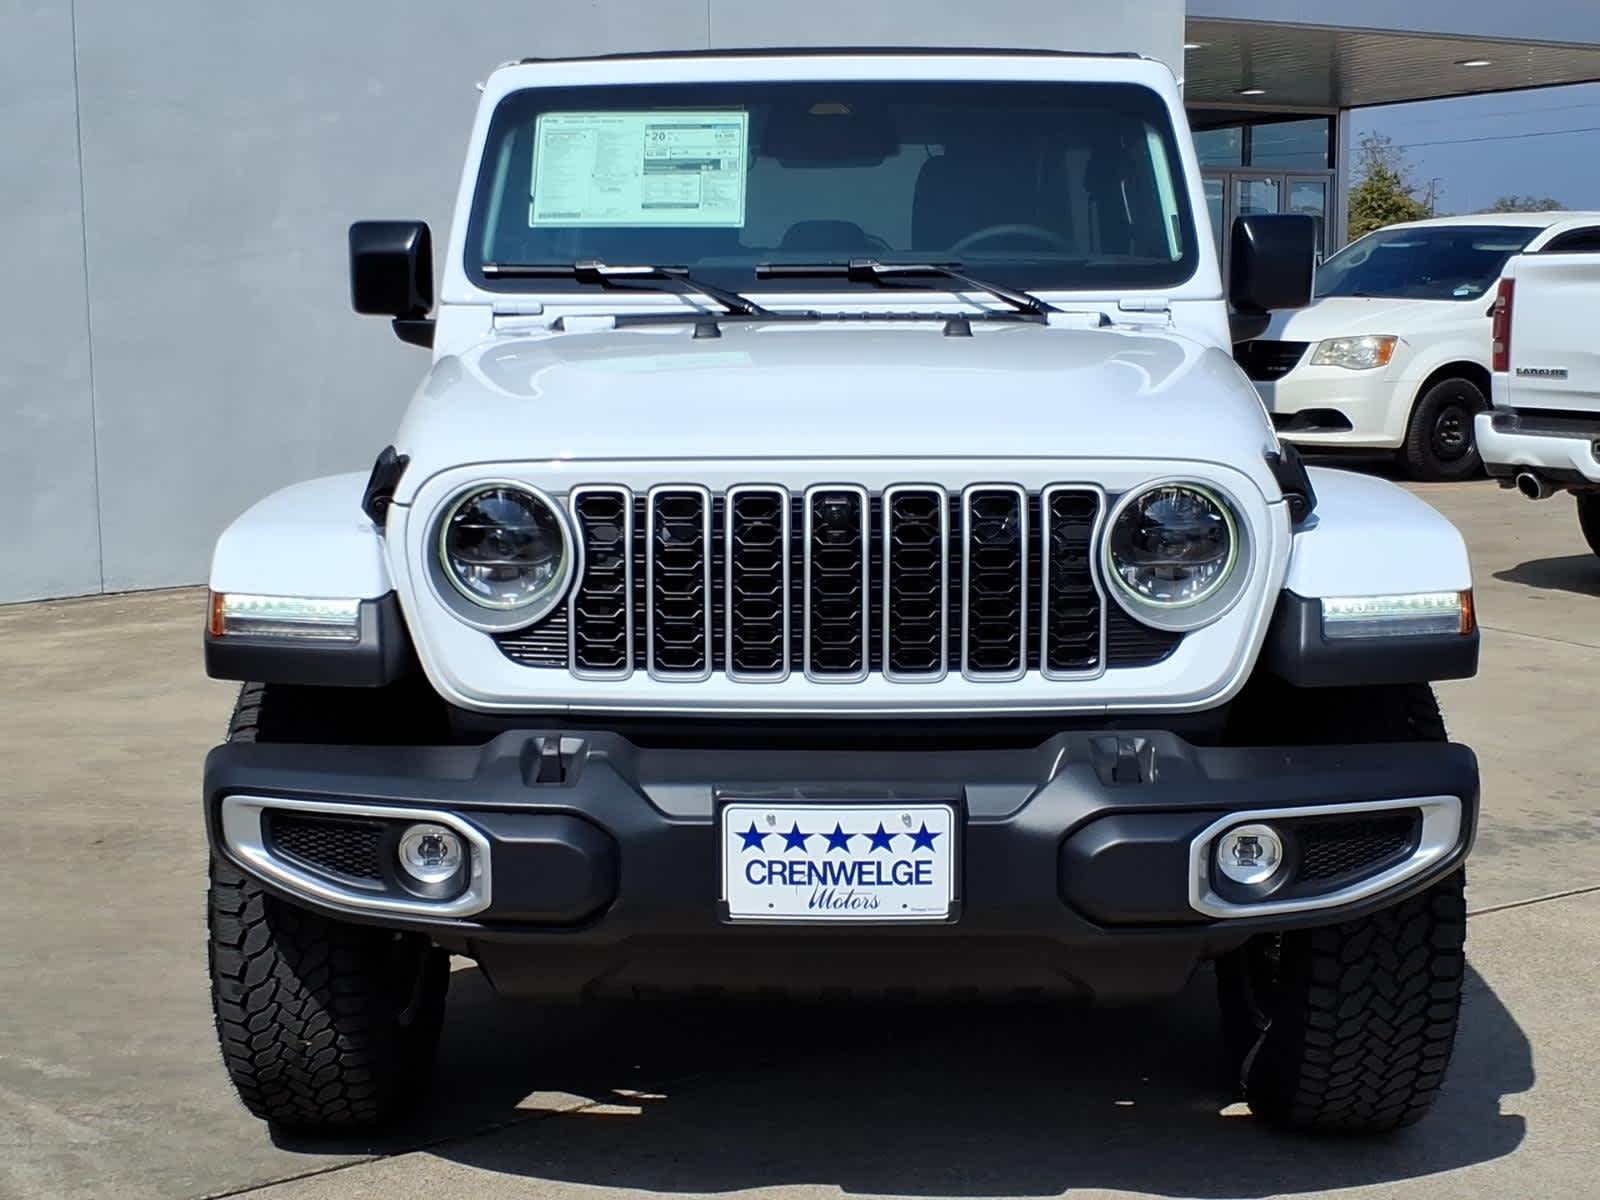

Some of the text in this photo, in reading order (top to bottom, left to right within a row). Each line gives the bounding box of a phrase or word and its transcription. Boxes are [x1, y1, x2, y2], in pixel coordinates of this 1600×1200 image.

[651, 132, 666, 141] 20
[745, 859, 933, 886] CRENWELGE
[807, 885, 881, 910] Motors
